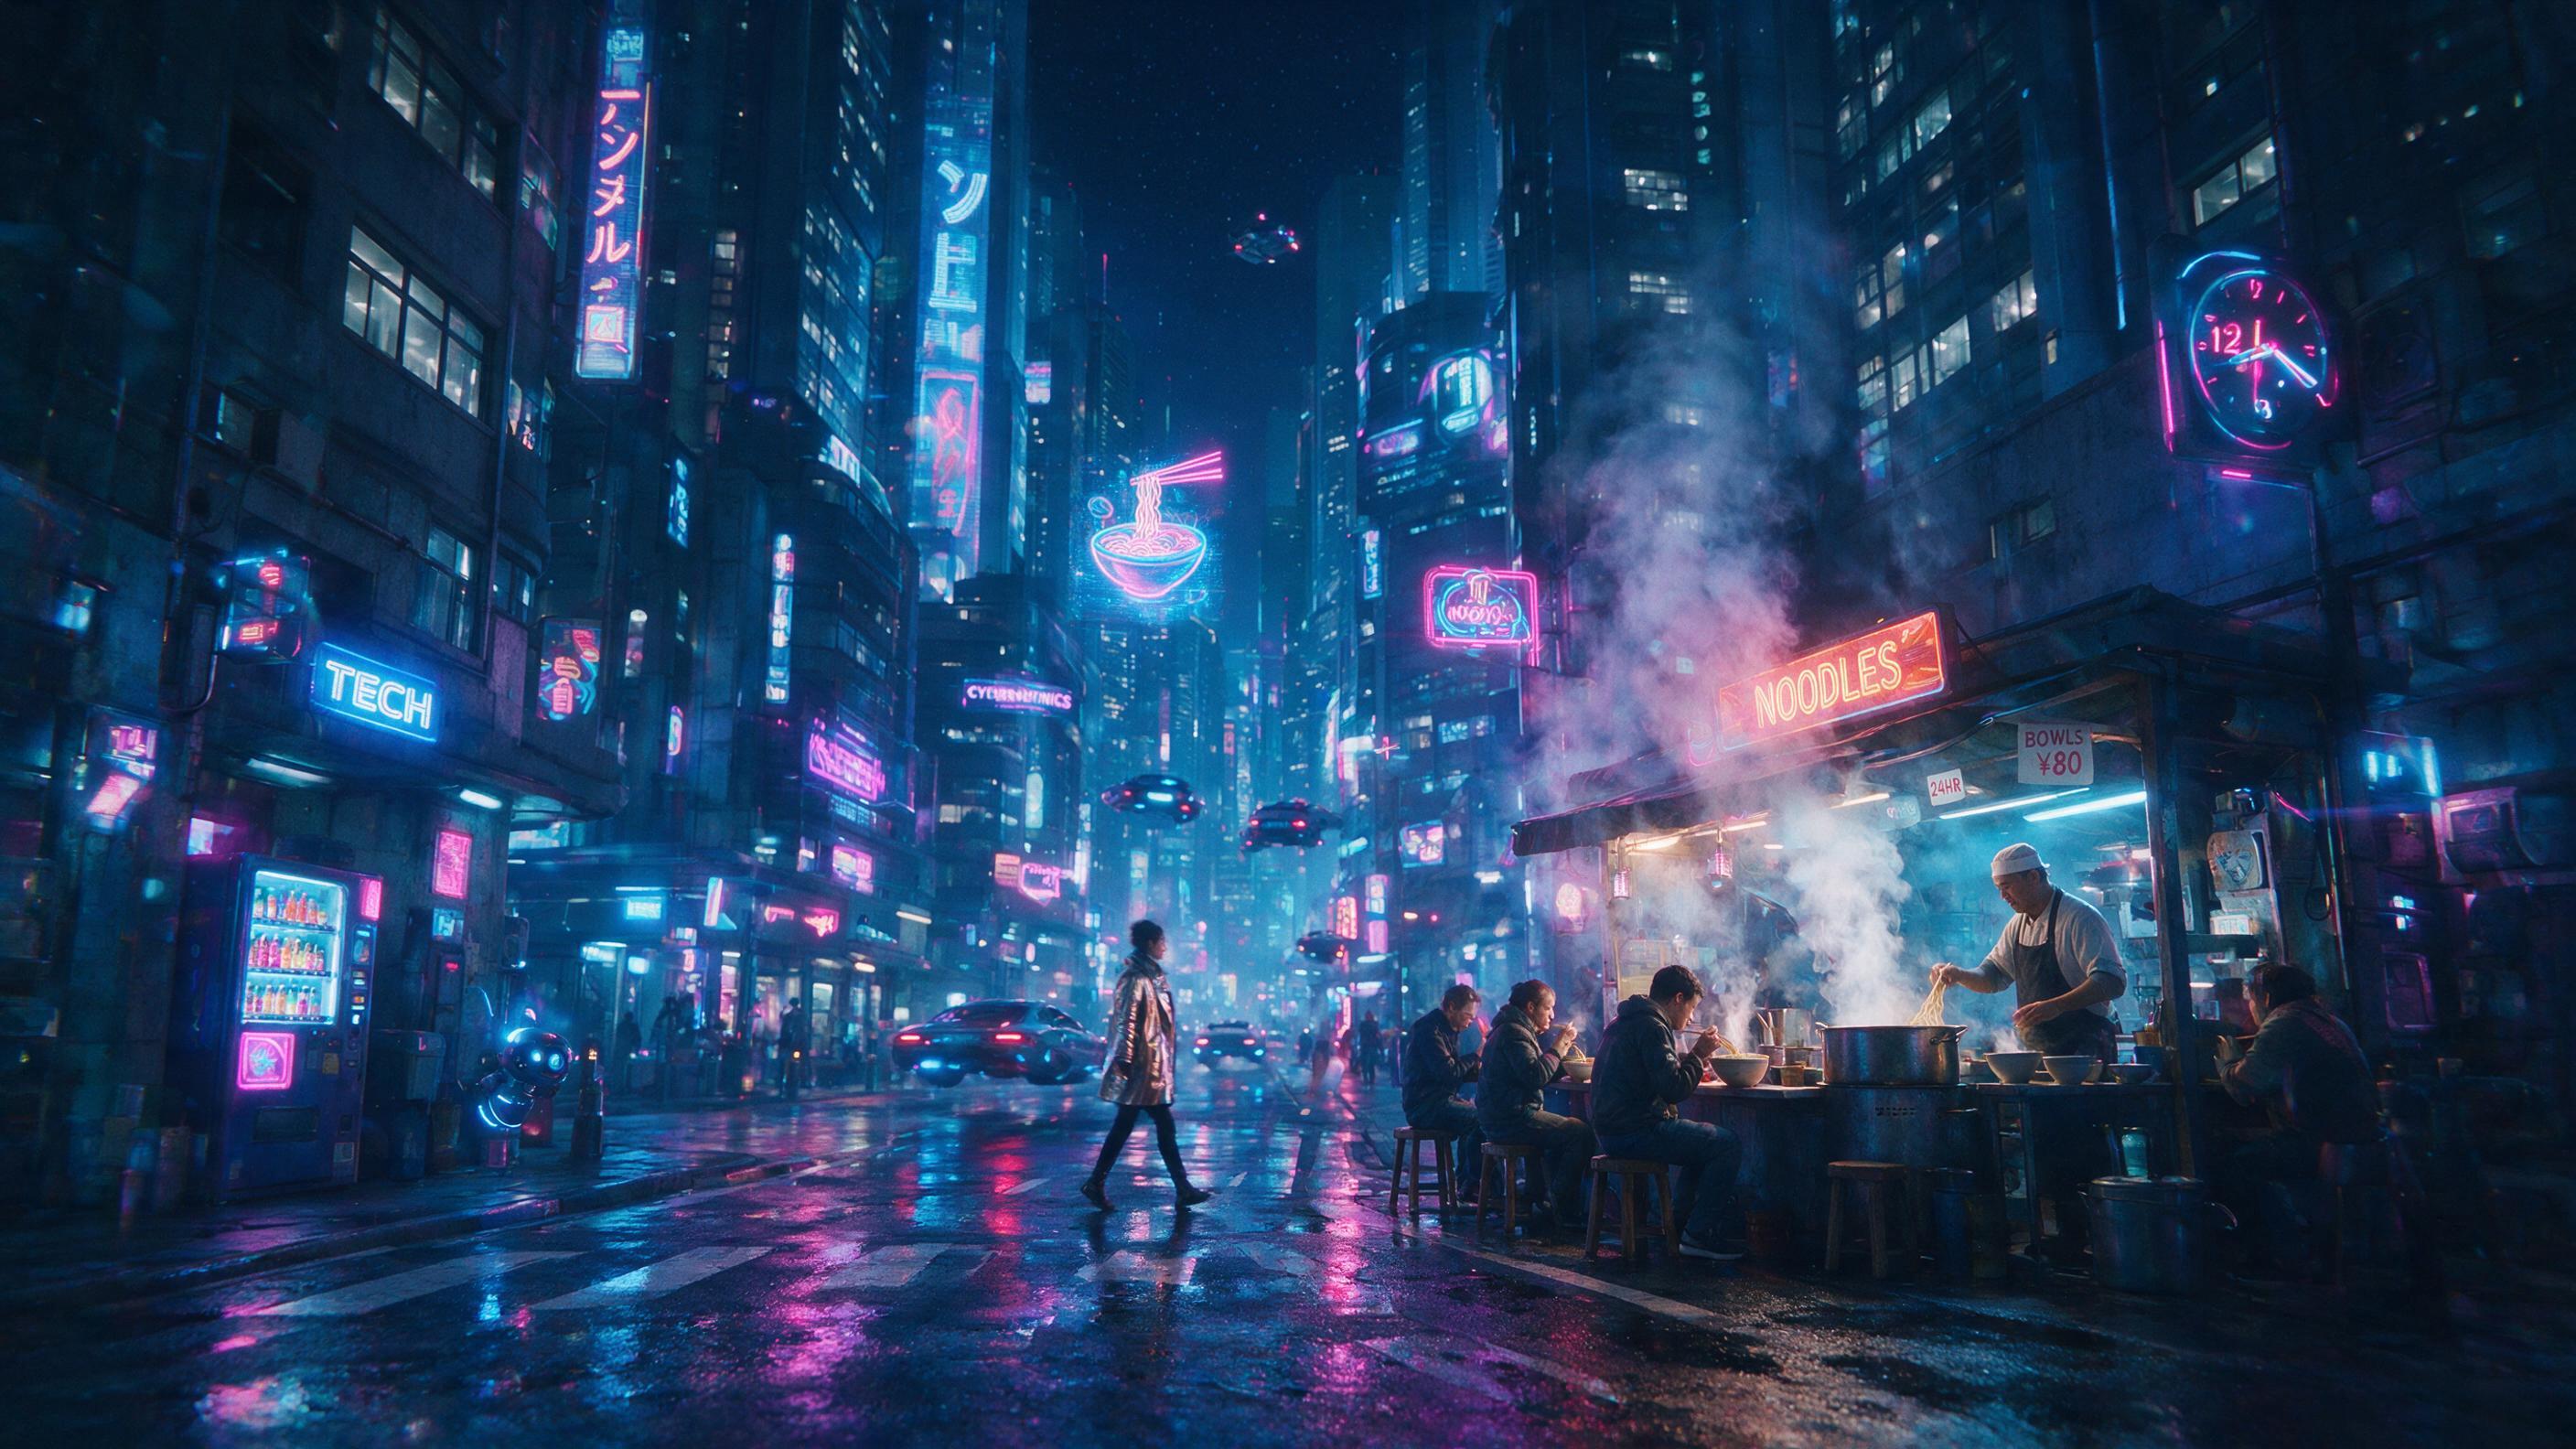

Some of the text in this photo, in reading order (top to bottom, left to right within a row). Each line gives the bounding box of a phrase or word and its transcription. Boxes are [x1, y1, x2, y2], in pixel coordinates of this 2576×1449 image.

[2211, 322, 2241, 354] 12
[326, 660, 433, 729] TECH
[2024, 729, 2084, 748] BOWLS
[2037, 750, 2082, 776] ¥80
[1930, 777, 1962, 798] 24HR
